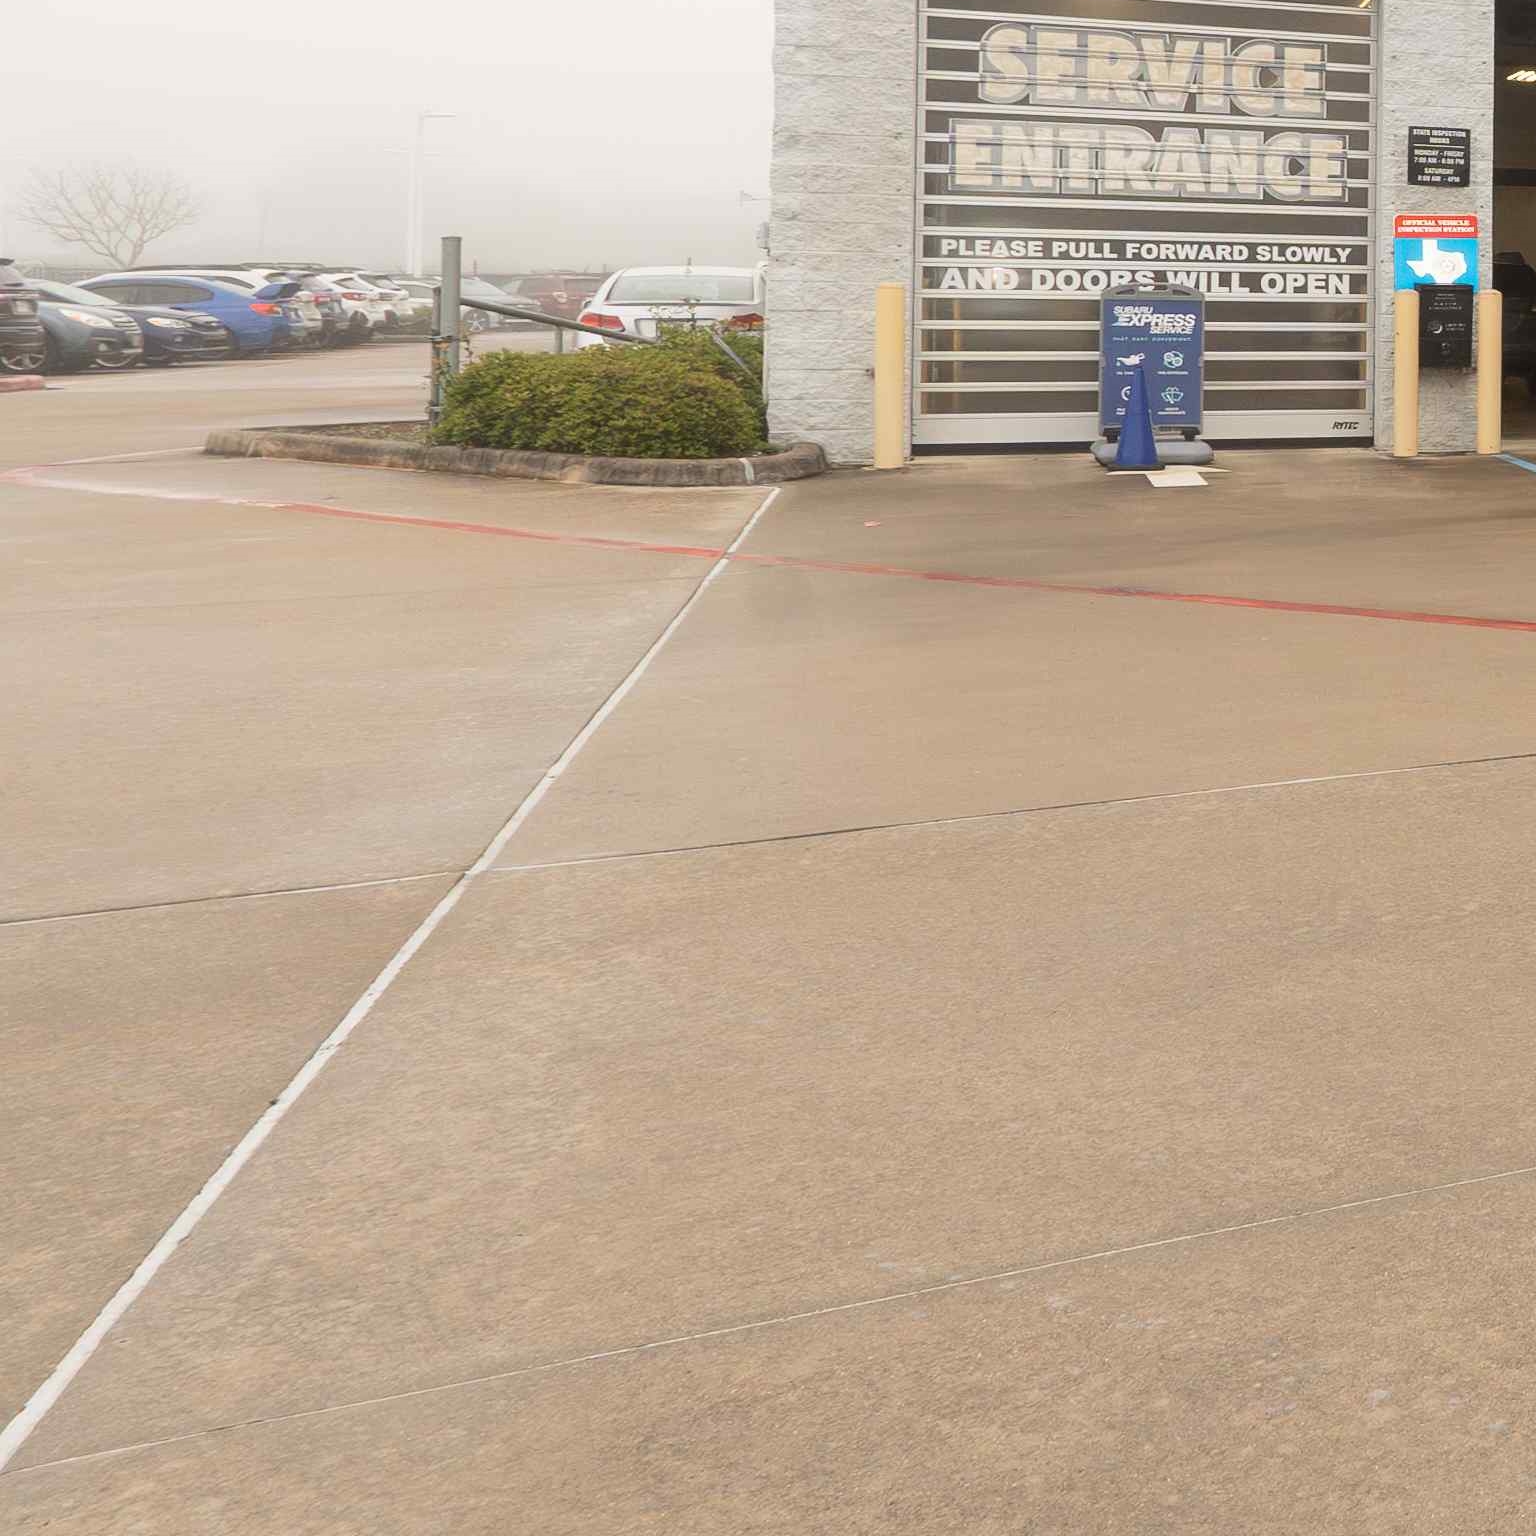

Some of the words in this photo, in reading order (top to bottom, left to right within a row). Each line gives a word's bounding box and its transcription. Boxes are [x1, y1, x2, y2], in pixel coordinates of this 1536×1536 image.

[979, 23, 1328, 118] SERVICE
[947, 118, 1349, 203] ENTRANCE
[940, 238, 1043, 259] PLEASE
[1052, 241, 1118, 260] PULL
[1125, 242, 1250, 263] FORWARD
[1255, 244, 1352, 264] SLOWLY
[939, 267, 1019, 291] AND
[1031, 268, 1155, 291] DOORS
[1166, 271, 1250, 293] WILL
[1260, 272, 1350, 295] OPEN
[1113, 305, 1153, 313] SUBARU
[1113, 313, 1196, 326] EXPRESS
[1149, 326, 1193, 334] SERVICE
